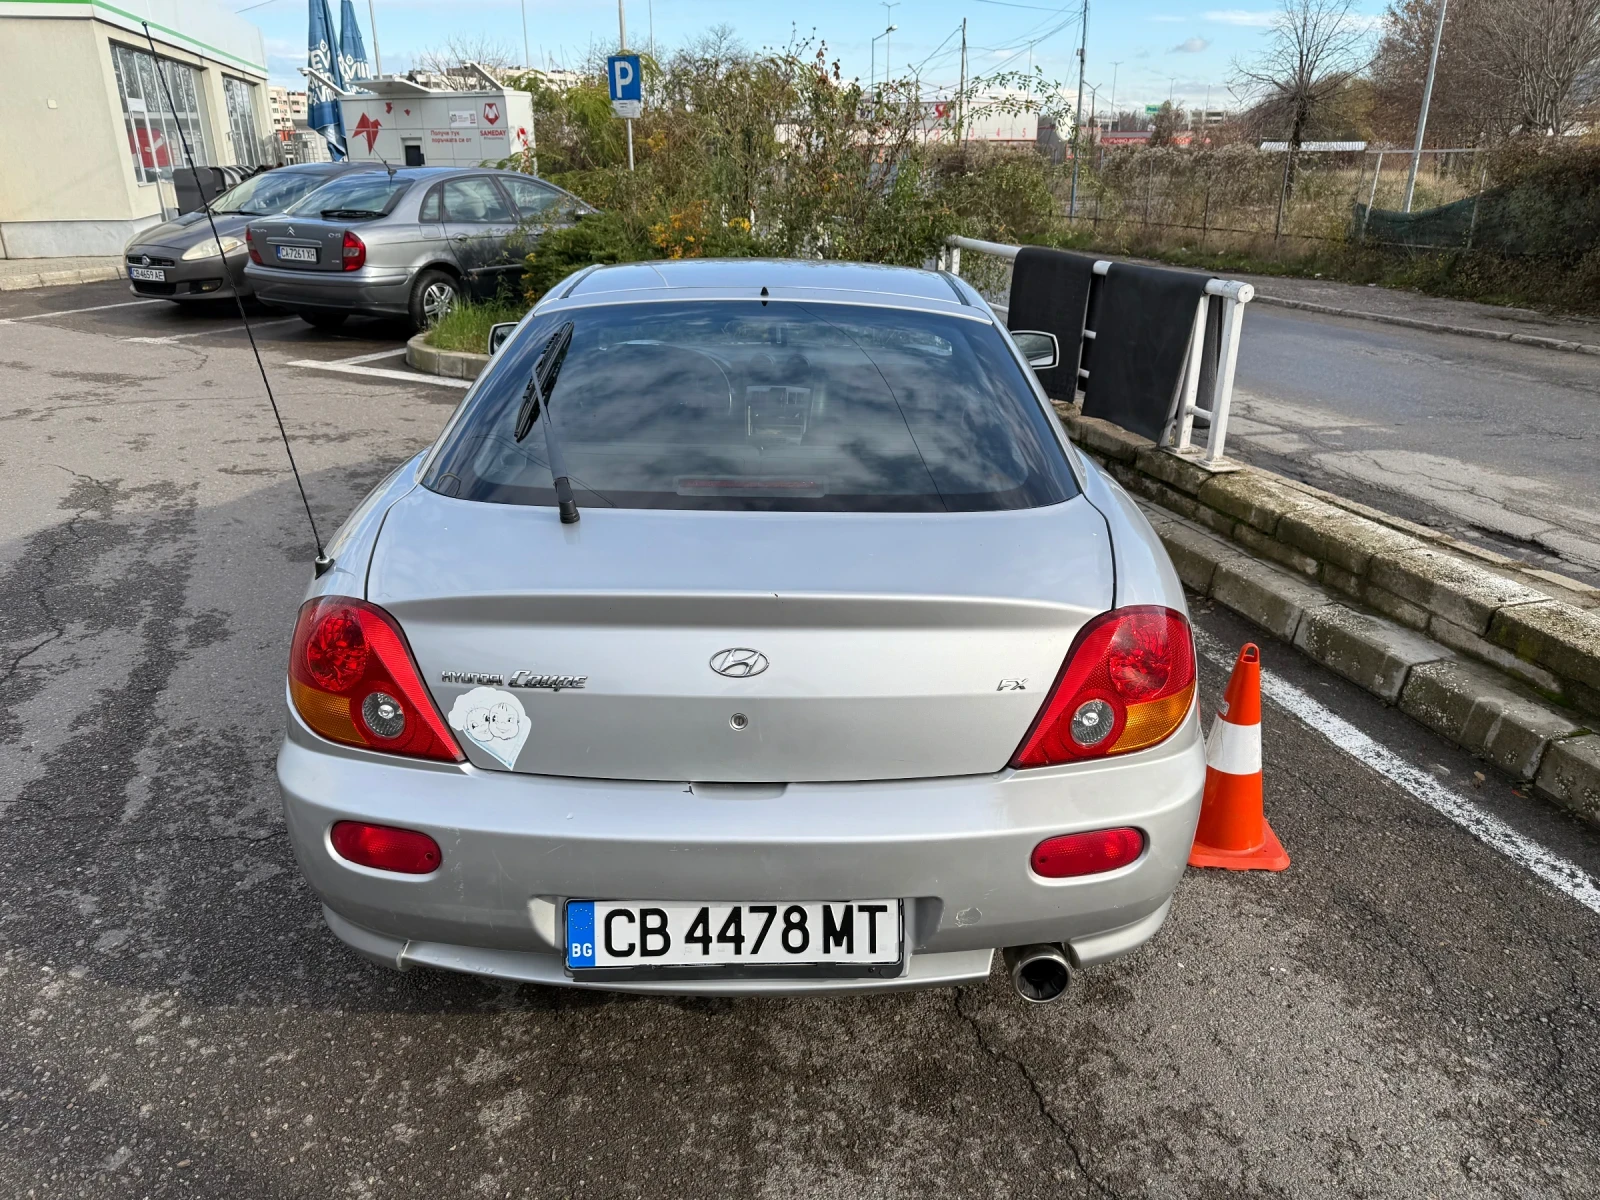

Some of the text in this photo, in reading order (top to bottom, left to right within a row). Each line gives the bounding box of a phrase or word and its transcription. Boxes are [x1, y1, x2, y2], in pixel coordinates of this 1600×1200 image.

[614, 61, 633, 98] P
[281, 247, 315, 260] CA 7261 XH
[140, 270, 154, 279] 4659
[155, 271, 164, 280] AE
[441, 669, 588, 692] HYUNDAI Coupe
[996, 678, 1029, 691] FX
[604, 904, 888, 957] CB 4478 MT
[572, 943, 593, 957] BG
